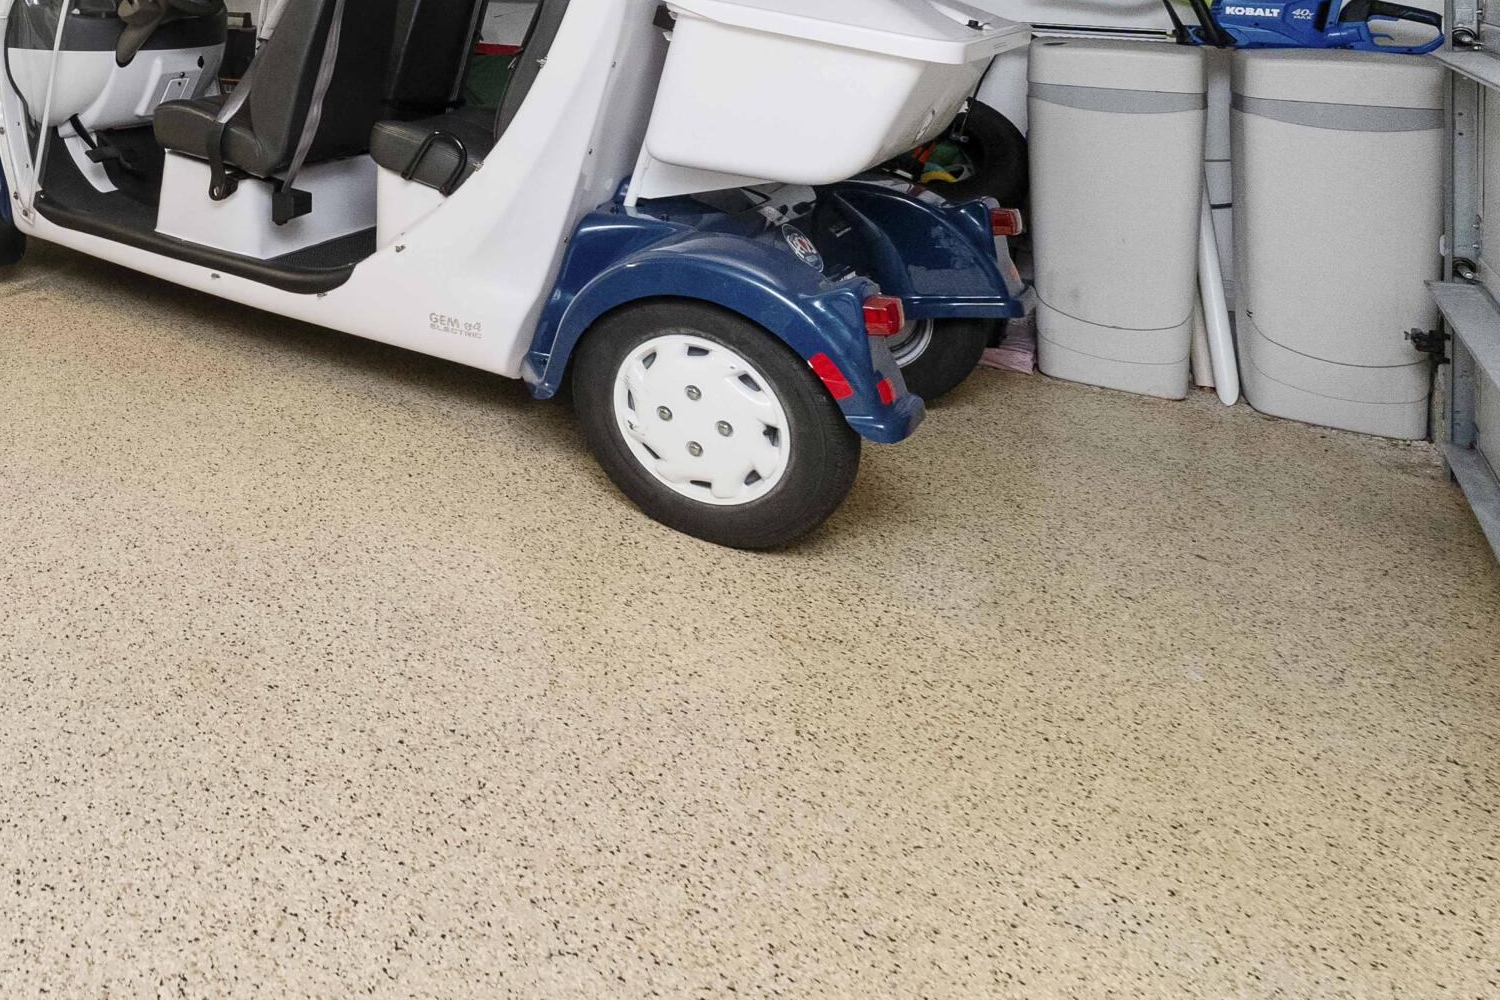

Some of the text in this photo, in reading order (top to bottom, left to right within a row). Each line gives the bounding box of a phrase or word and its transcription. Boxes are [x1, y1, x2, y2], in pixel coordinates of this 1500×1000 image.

[1225, 6, 1280, 17] KOBALT
[429, 312, 460, 329] GEM
[429, 323, 483, 339] ELECTRIC
